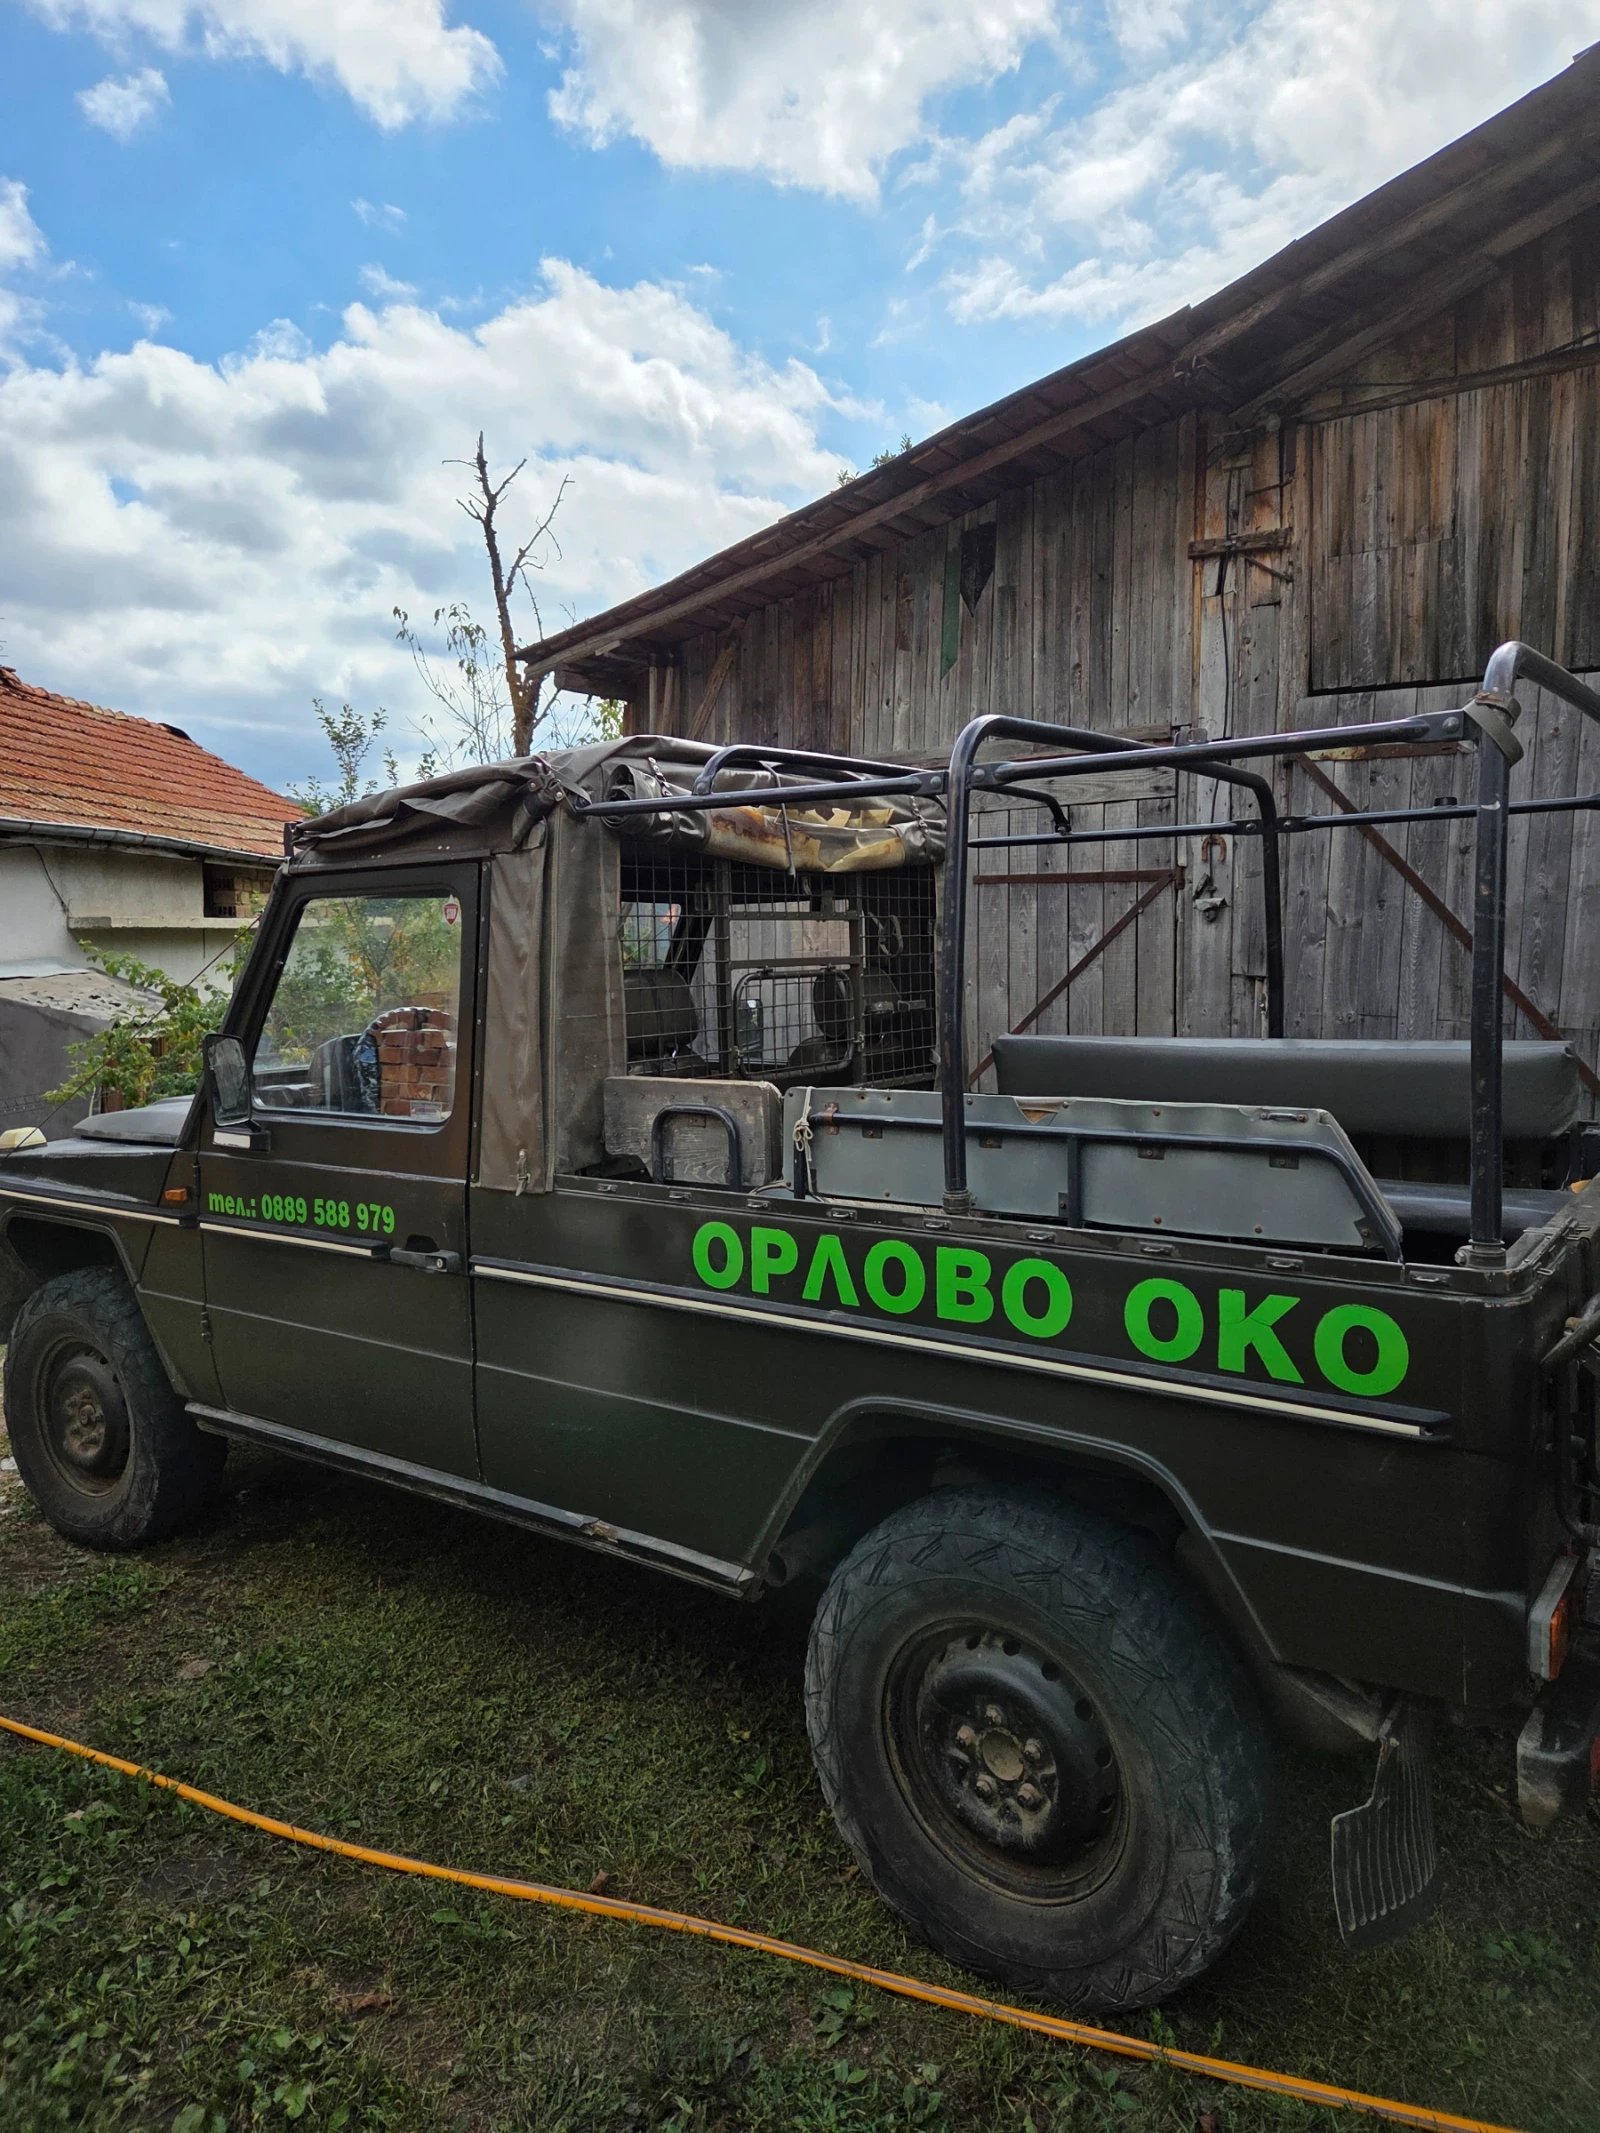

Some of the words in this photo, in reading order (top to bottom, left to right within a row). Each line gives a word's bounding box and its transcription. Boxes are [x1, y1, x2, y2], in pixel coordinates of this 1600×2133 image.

[261, 1194, 308, 1224] 0889
[314, 1198, 350, 1228] 588
[356, 1203, 395, 1234] 979
[692, 1221, 1073, 1338] ОРЛОВО
[1124, 1278, 1409, 1397] ОКО
